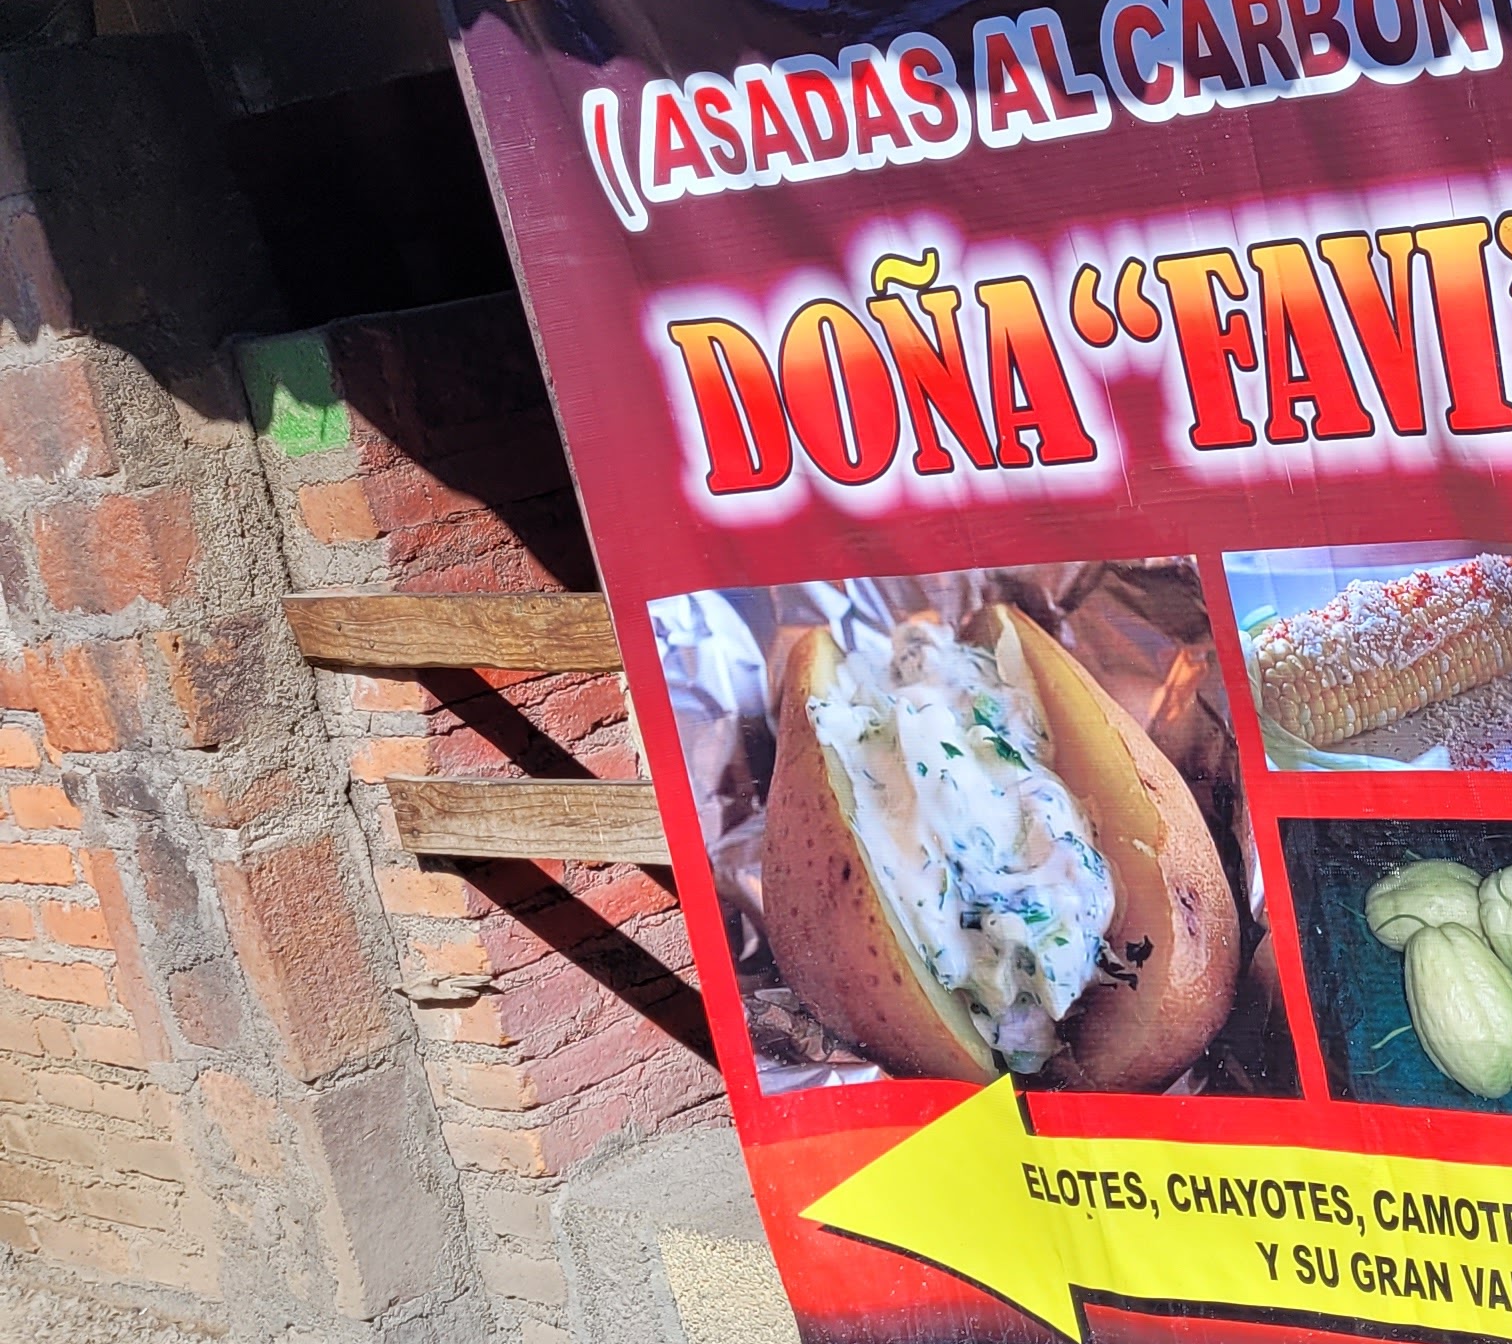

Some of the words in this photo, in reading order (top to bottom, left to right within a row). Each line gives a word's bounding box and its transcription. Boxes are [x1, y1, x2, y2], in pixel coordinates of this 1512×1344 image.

[975, 9, 1112, 145] AL
[668, 248, 1098, 497] DOÑA
[1022, 1162, 1160, 1218] ELOTES,
[1167, 1172, 1365, 1237] CHAYOTES,
[1256, 1241, 1280, 1281] Y
[1294, 1243, 1339, 1289] SU
[1351, 1251, 1454, 1304] GRAN
